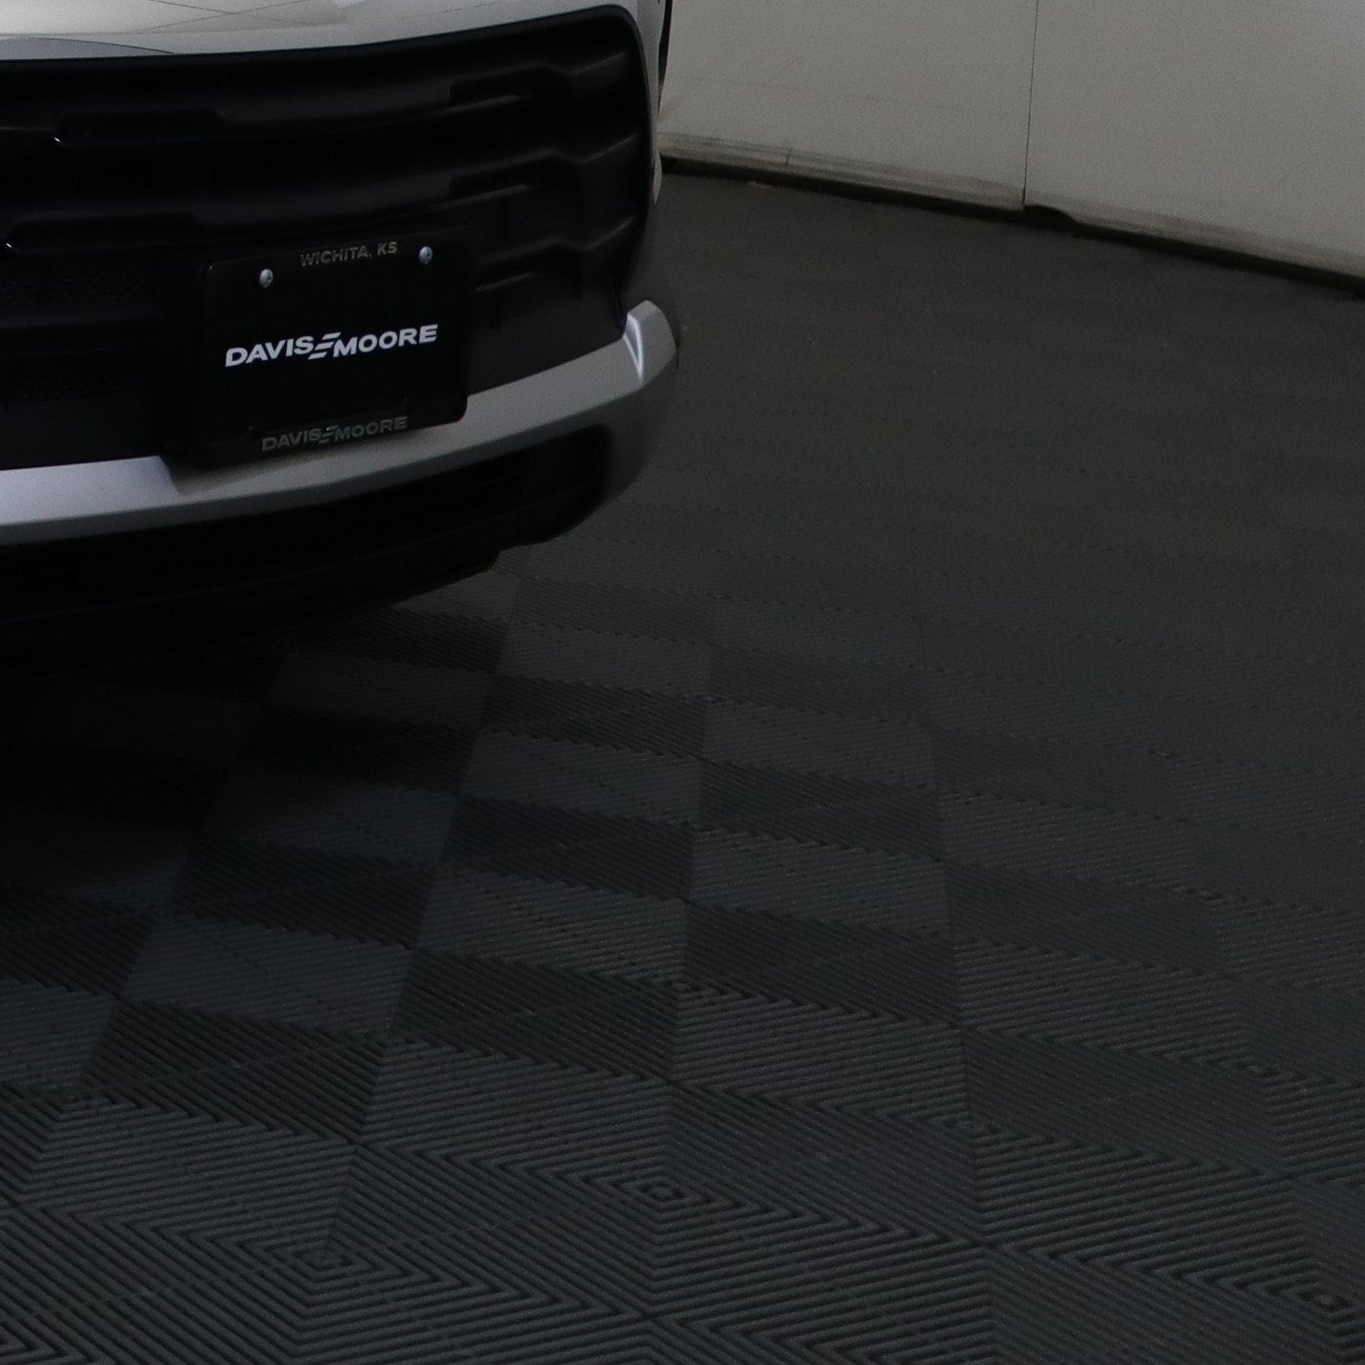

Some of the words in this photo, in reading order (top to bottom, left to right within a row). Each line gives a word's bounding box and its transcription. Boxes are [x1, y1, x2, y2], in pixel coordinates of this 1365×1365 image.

[377, 240, 398, 257] KS
[225, 334, 314, 368] DAVIS
[332, 323, 439, 359] MOORE
[261, 426, 322, 452] DAVIS
[333, 415, 408, 442] MOORE
